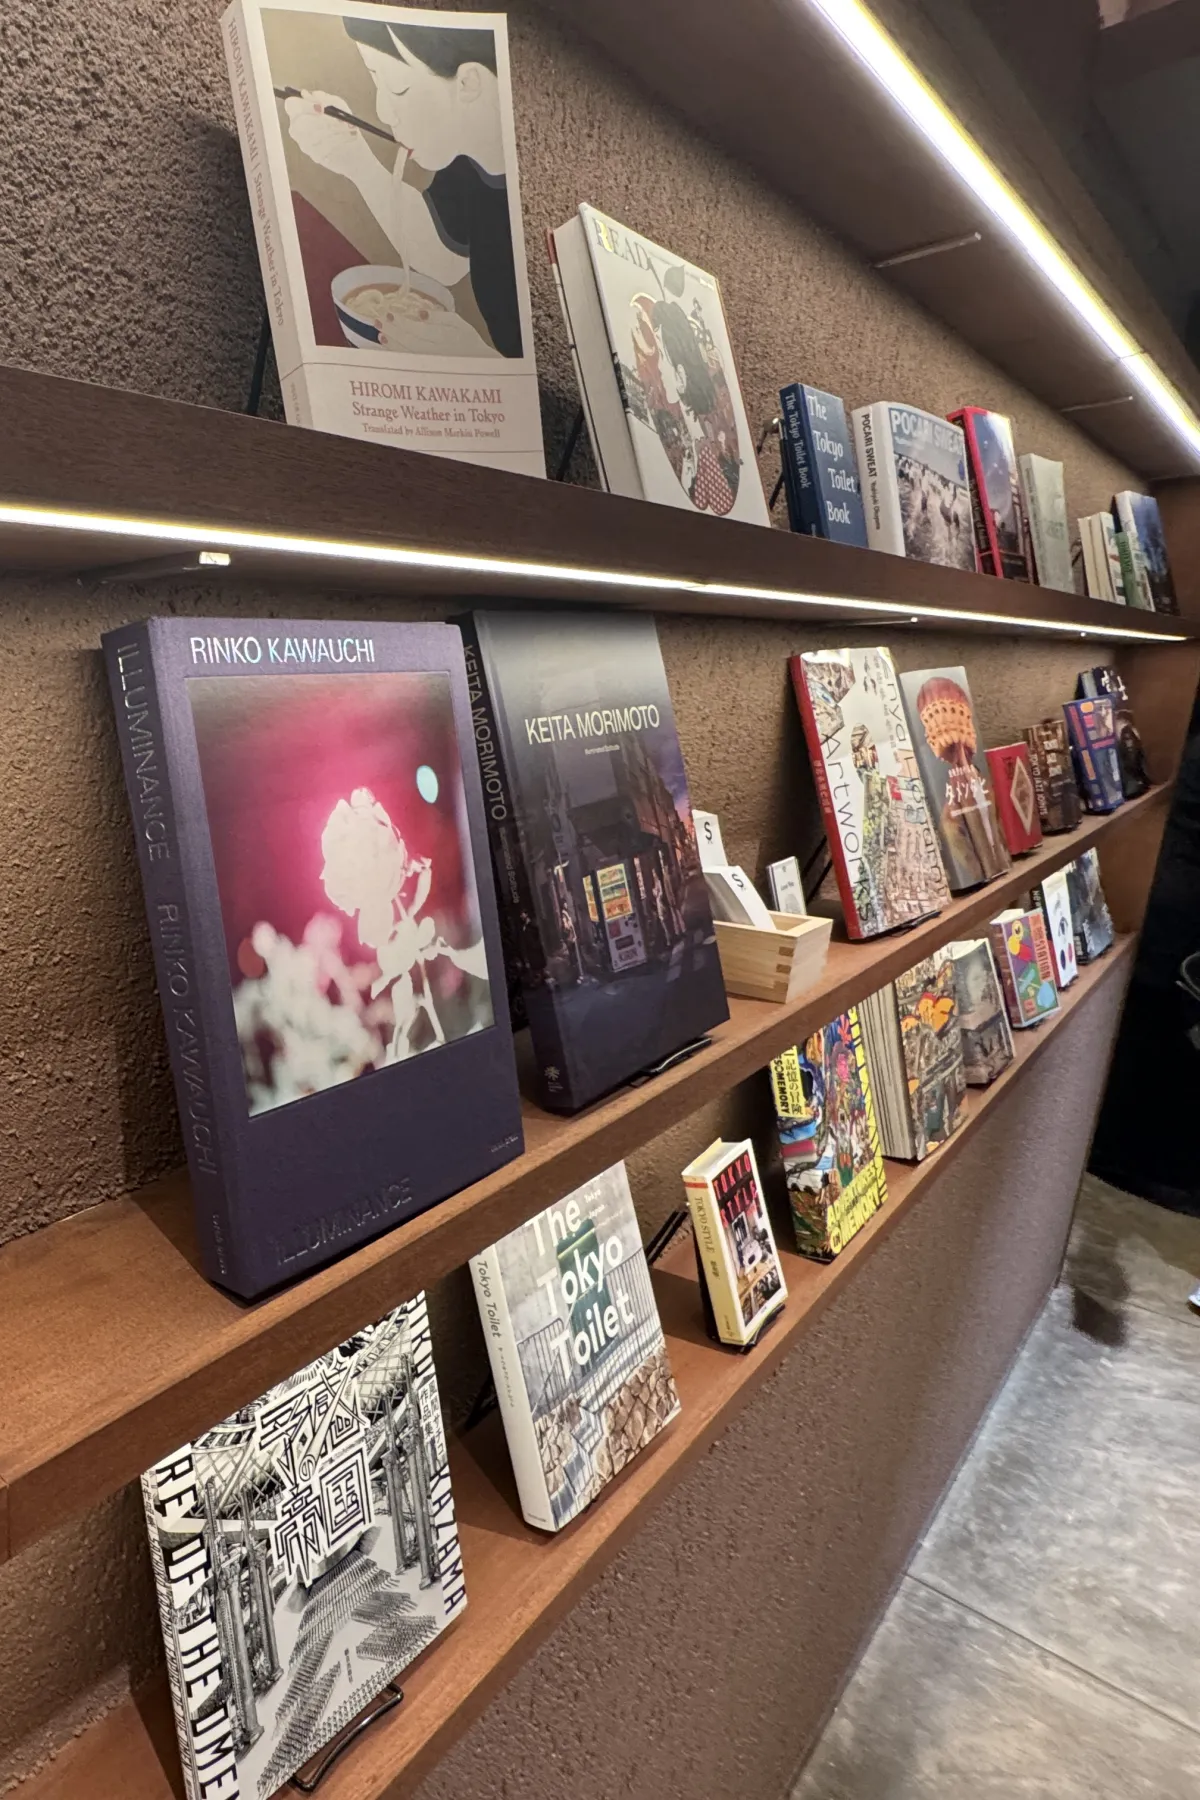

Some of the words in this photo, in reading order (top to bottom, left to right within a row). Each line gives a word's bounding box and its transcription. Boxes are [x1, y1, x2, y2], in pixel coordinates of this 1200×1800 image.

[228, 17, 245, 79] HIROMI
[238, 78, 259, 158] KAWAKAMI
[273, 286, 284, 325] Tokyo
[350, 381, 412, 400] HIROMI
[416, 386, 503, 404] KAWAKAMI
[352, 402, 399, 421] Strange
[401, 405, 451, 421] Weather
[453, 409, 466, 421] in
[468, 409, 505, 424] Tokyo
[785, 393, 796, 410] The
[807, 395, 827, 421] The
[788, 411, 800, 439] Tokyo
[813, 430, 843, 461] Tokyo
[861, 413, 872, 448] POCARI
[890, 410, 930, 440] POCARI
[794, 440, 806, 465] Toilet
[865, 448, 877, 477] SWEAT
[798, 467, 812, 488] Book
[828, 468, 856, 492] Toilet
[826, 501, 851, 524] Book
[189, 636, 262, 664] RINKO
[267, 637, 376, 663] KAWAUCHI
[464, 645, 483, 704] KEITA
[525, 715, 576, 745] KEITA
[576, 704, 660, 738] MORIMOTO
[117, 642, 170, 862] ILLUMINANCE
[472, 707, 507, 820] MORIMOTO
[157, 903, 190, 996] RINKO
[172, 1008, 218, 1175] KAWAUCHI
[712, 1154, 751, 1200] TOKYO
[695, 1197, 709, 1224] TOKYO
[702, 1224, 716, 1253] STYLE
[719, 1181, 759, 1228] STYLE
[523, 1198, 582, 1256] The
[536, 1235, 623, 1317] Tokyo
[477, 1261, 492, 1298] Tokyo
[486, 1301, 501, 1339] Toilet
[550, 1286, 635, 1380] Toilet
[428, 1463, 468, 1616] KAZAMA
[161, 1535, 214, 1588] OF
[177, 1605, 224, 1699] THE
